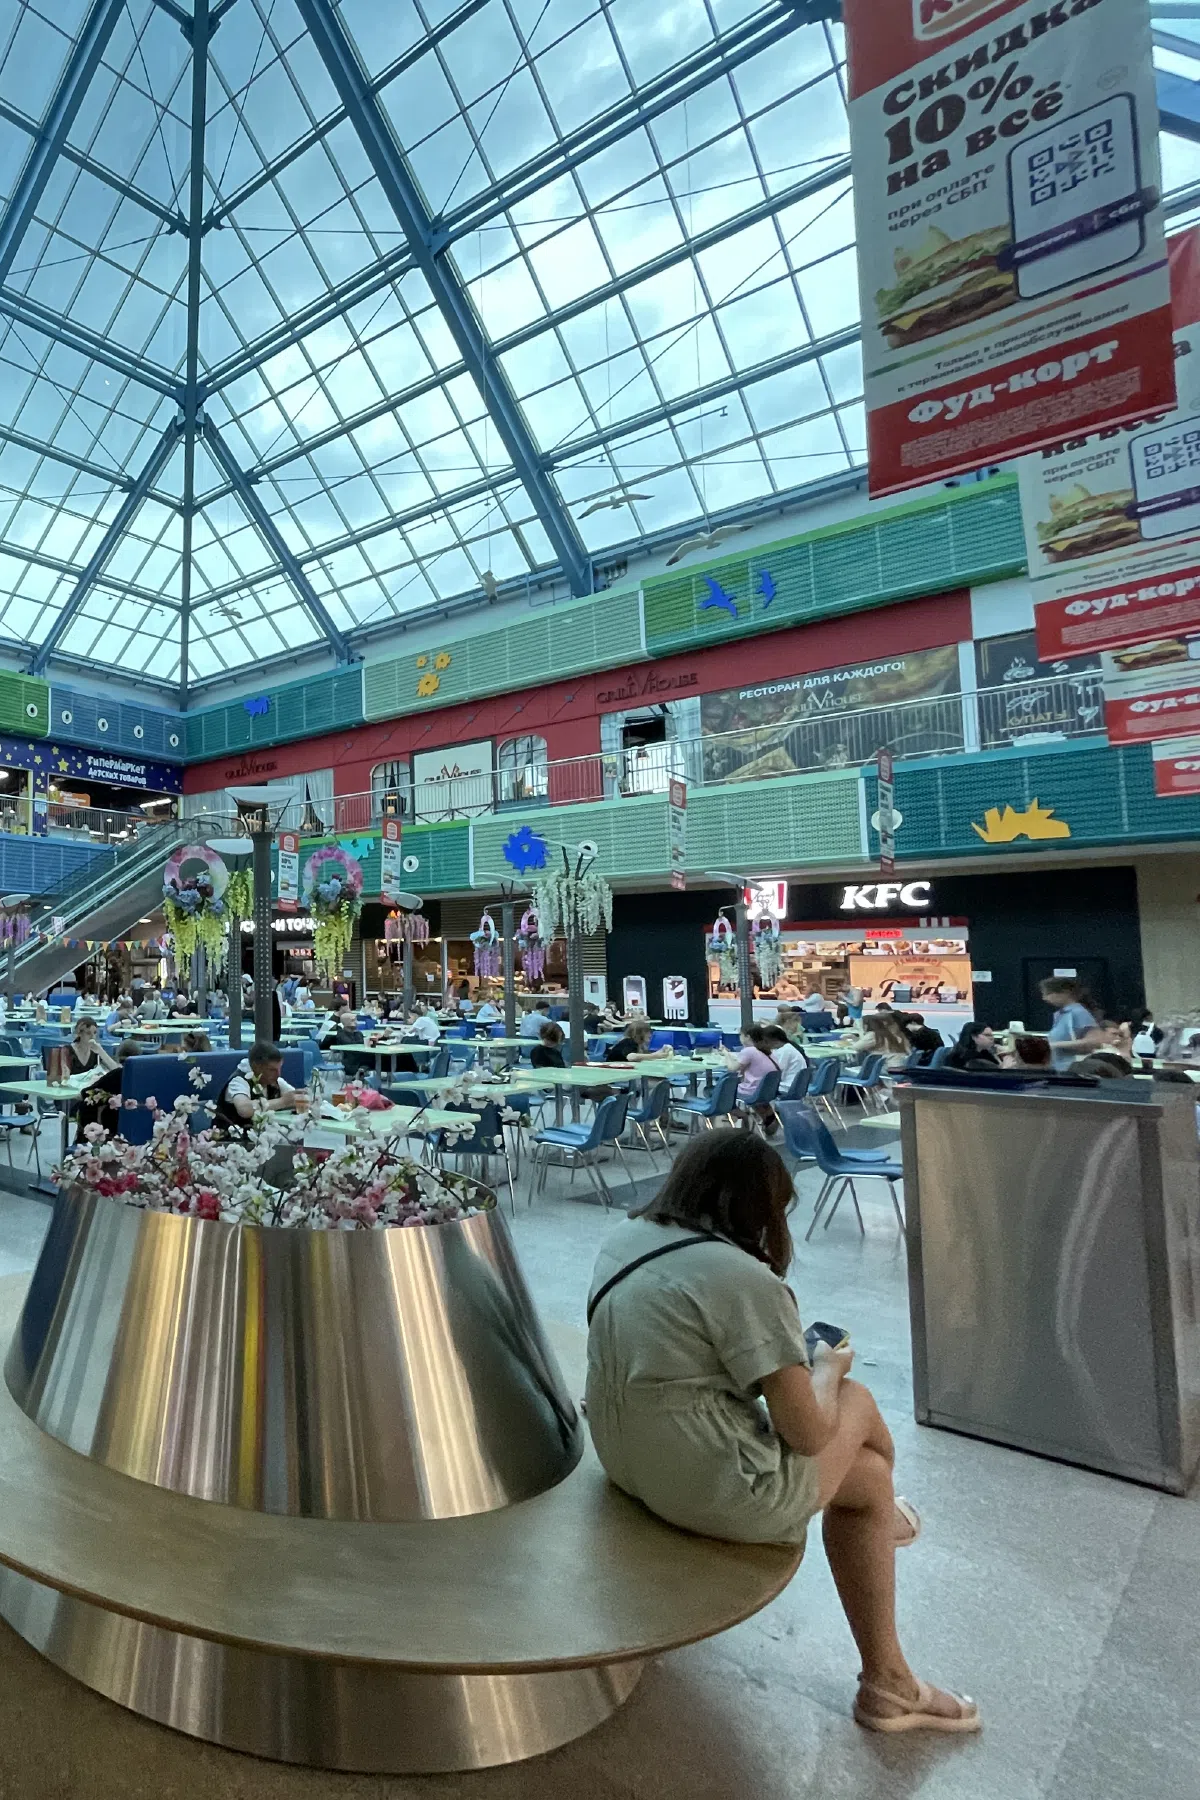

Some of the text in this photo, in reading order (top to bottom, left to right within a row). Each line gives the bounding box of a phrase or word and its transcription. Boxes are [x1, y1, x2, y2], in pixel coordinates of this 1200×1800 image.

[883, 0, 1101, 116] Скидка
[885, 60, 1034, 165] 10%
[886, 81, 1064, 196] на всё
[888, 163, 996, 221] при оплате
[888, 179, 988, 231] через СБП
[908, 339, 1119, 423] Фуд-корт
[739, 661, 906, 700] РЕСТОРАН ДЛЯ КАЖДОГО!
[840, 881, 931, 910] KFC
